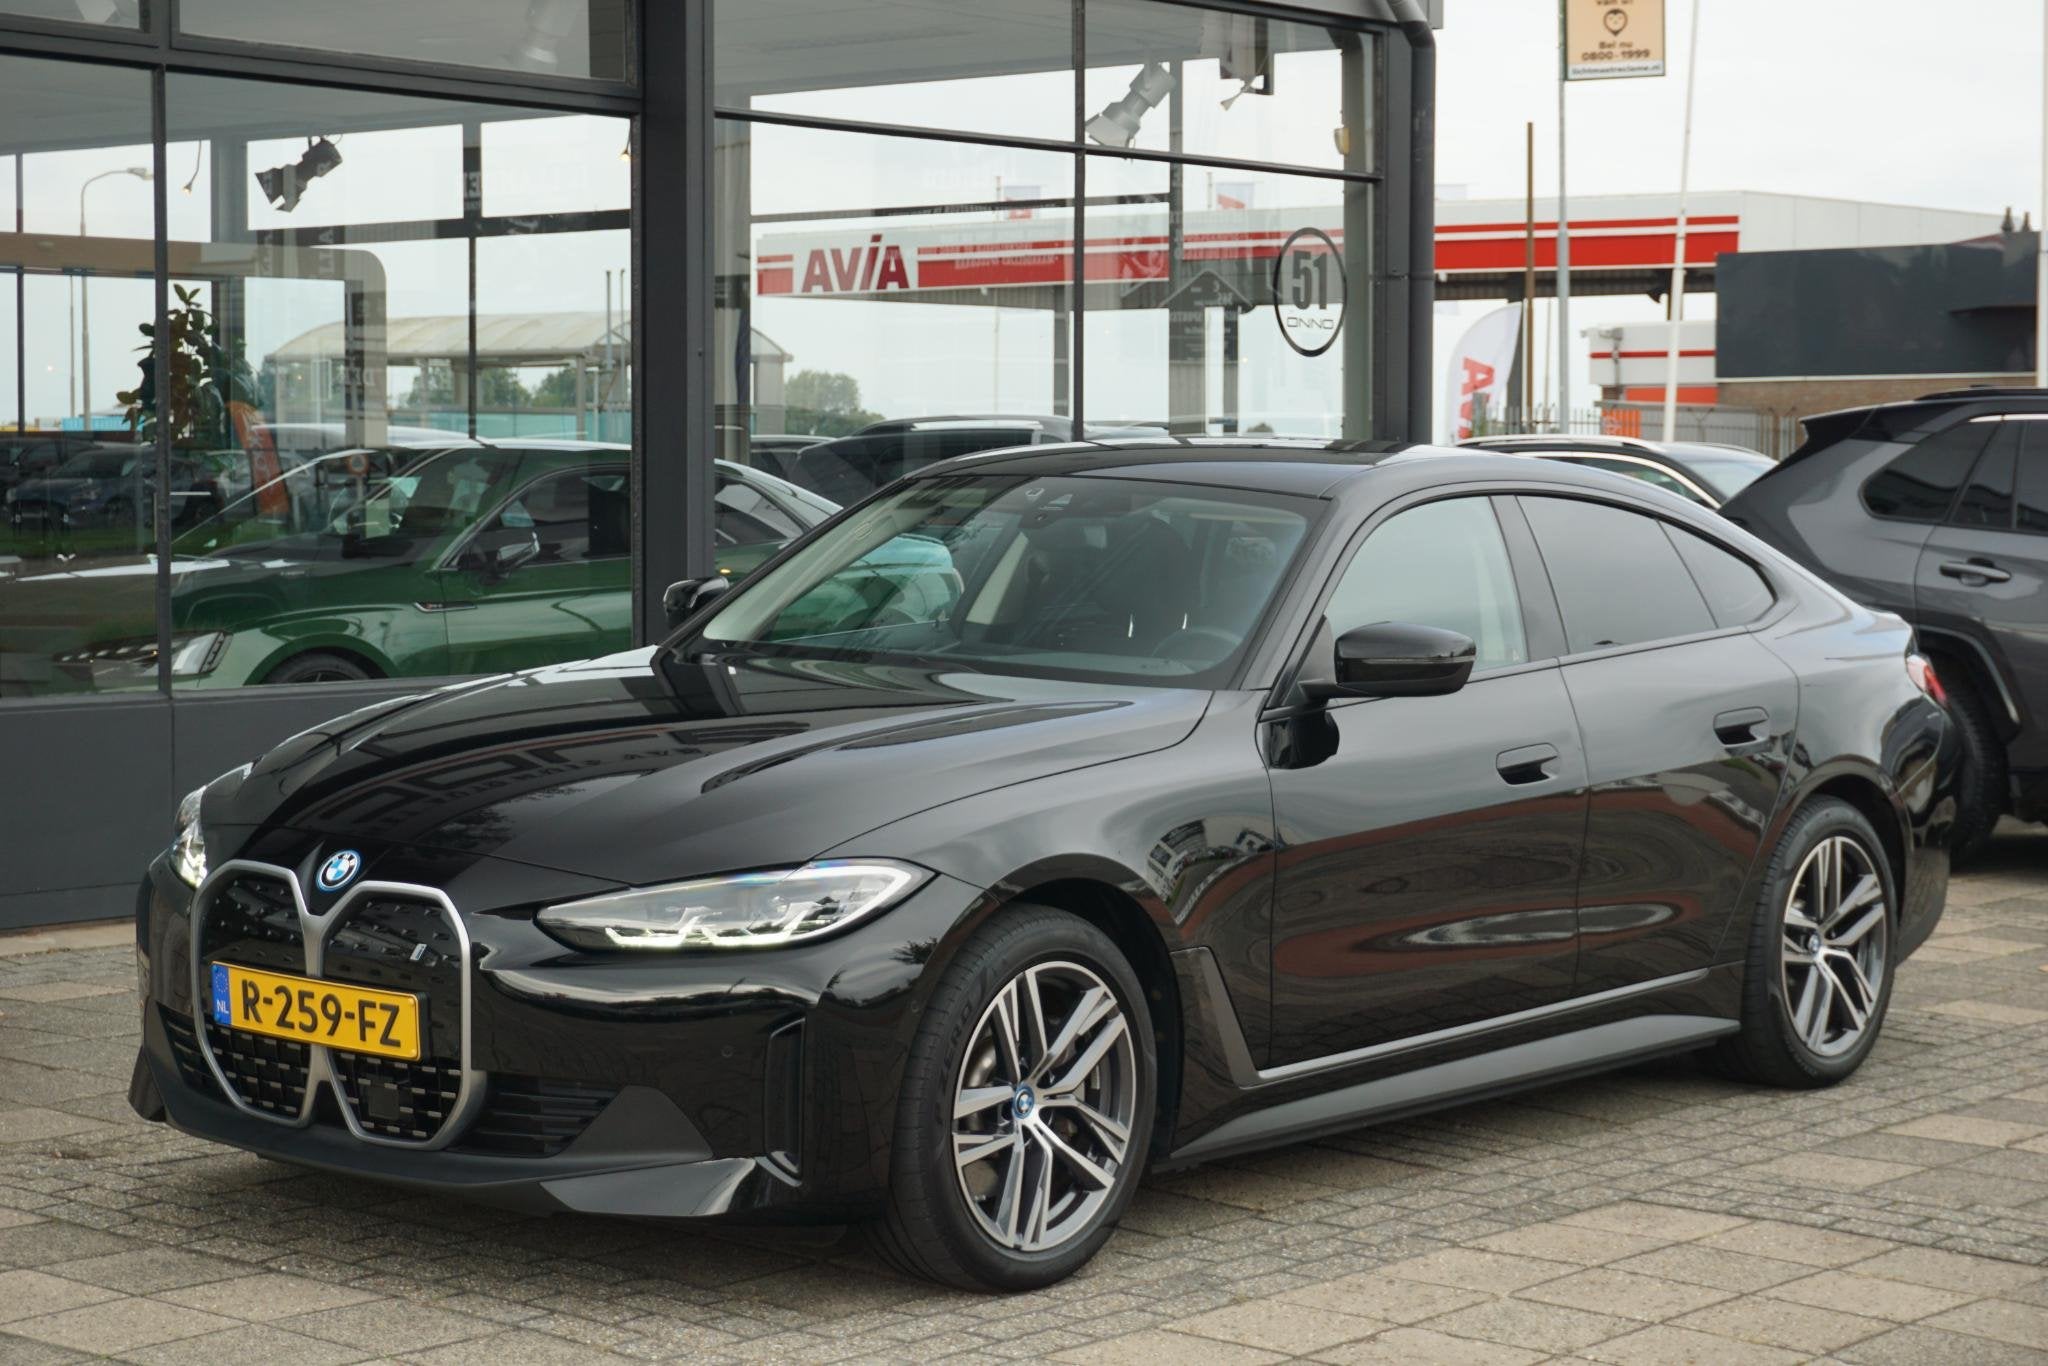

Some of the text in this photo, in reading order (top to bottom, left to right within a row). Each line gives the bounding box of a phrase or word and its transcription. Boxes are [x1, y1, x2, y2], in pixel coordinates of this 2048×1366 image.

[1292, 250, 1327, 310] 51
[1287, 316, 1334, 330] ONNO
[216, 999, 230, 1015] NL
[241, 979, 402, 1048] R-259-FZ
